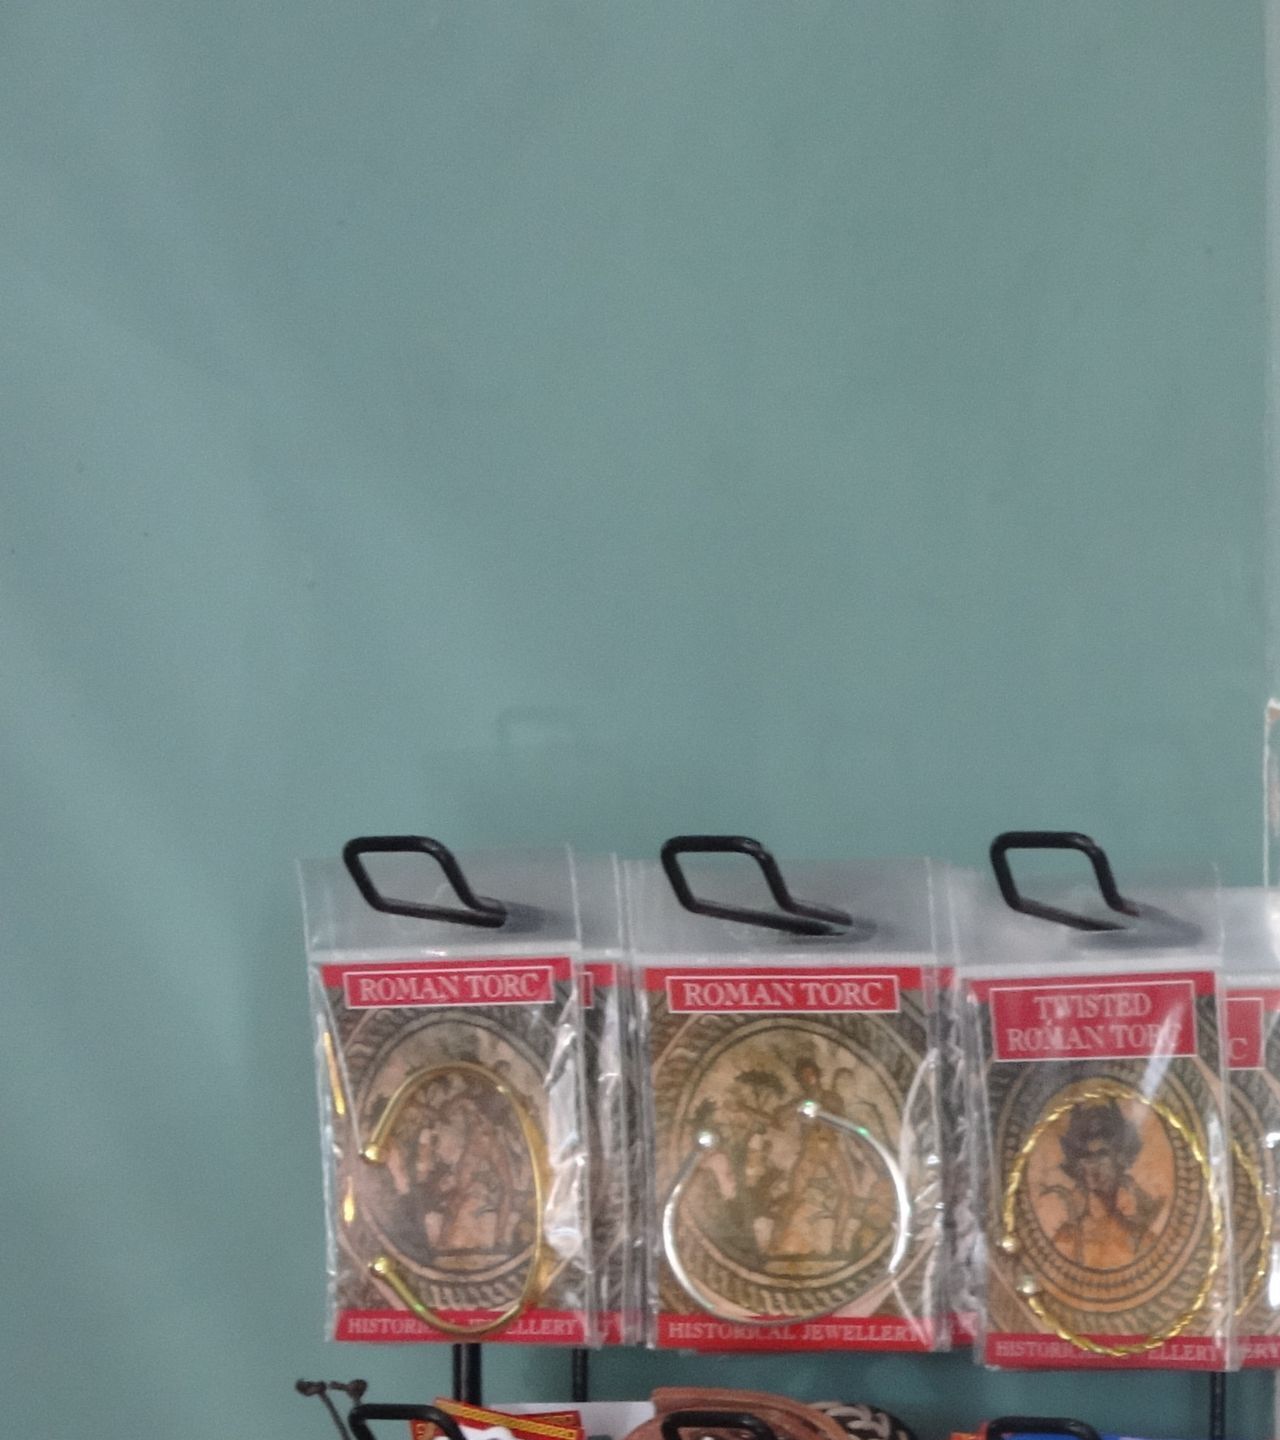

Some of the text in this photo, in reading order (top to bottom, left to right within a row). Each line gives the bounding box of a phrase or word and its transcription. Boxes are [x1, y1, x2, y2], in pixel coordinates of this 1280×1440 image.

[359, 973, 540, 1001] ROMAN TORC
[683, 982, 883, 1006] ROMAN TORC
